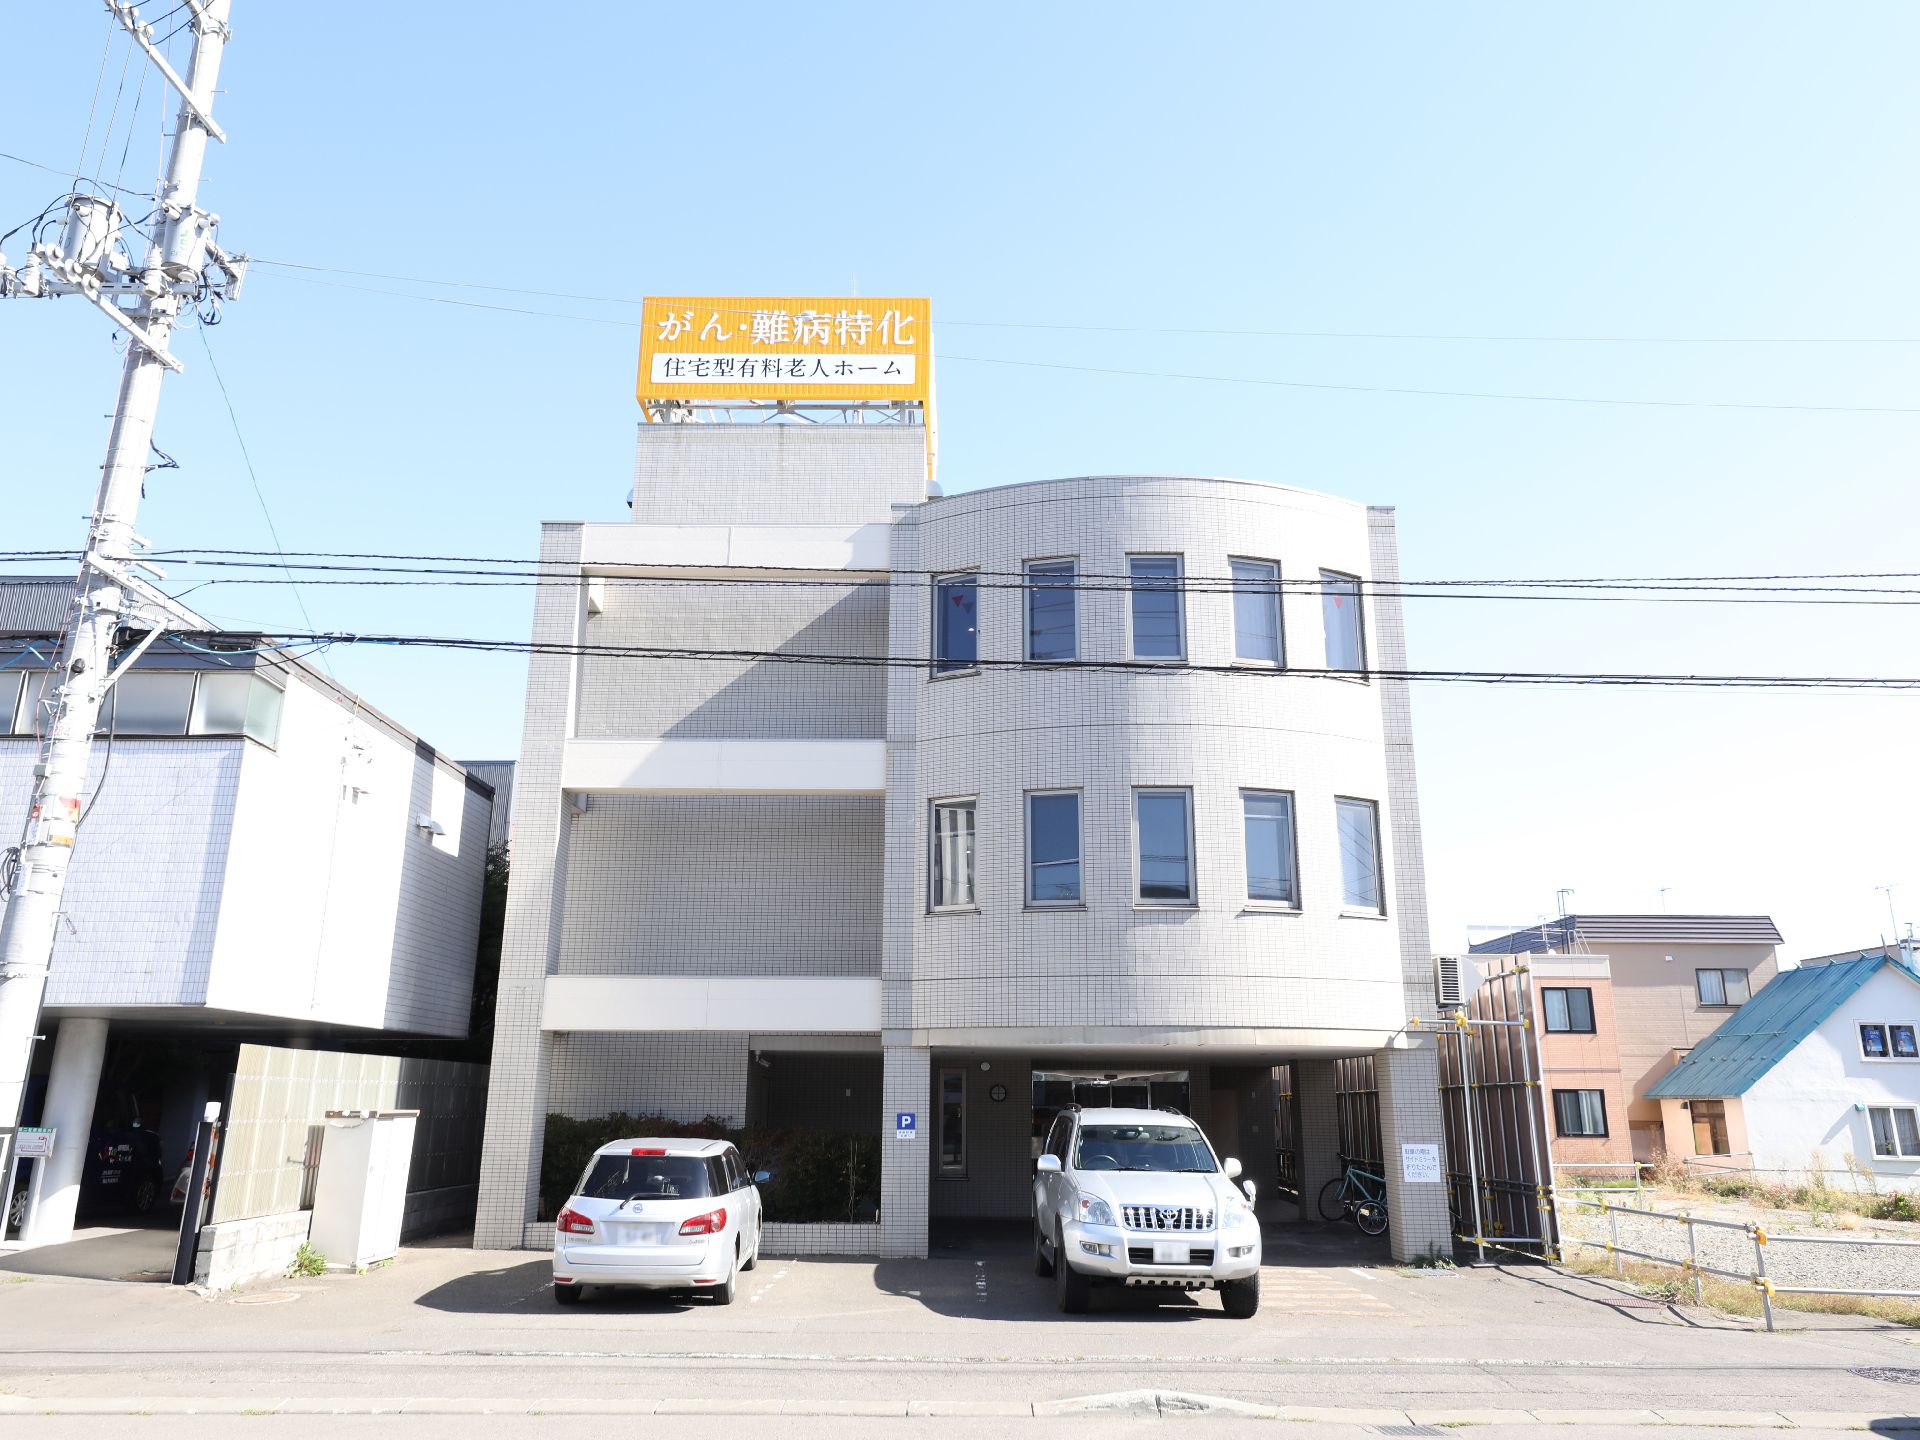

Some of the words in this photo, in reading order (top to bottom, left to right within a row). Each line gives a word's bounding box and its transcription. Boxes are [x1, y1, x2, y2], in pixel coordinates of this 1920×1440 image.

[663, 357, 901, 378] 住宅型有料老人ホーム
[901, 1115, 912, 1128] P
